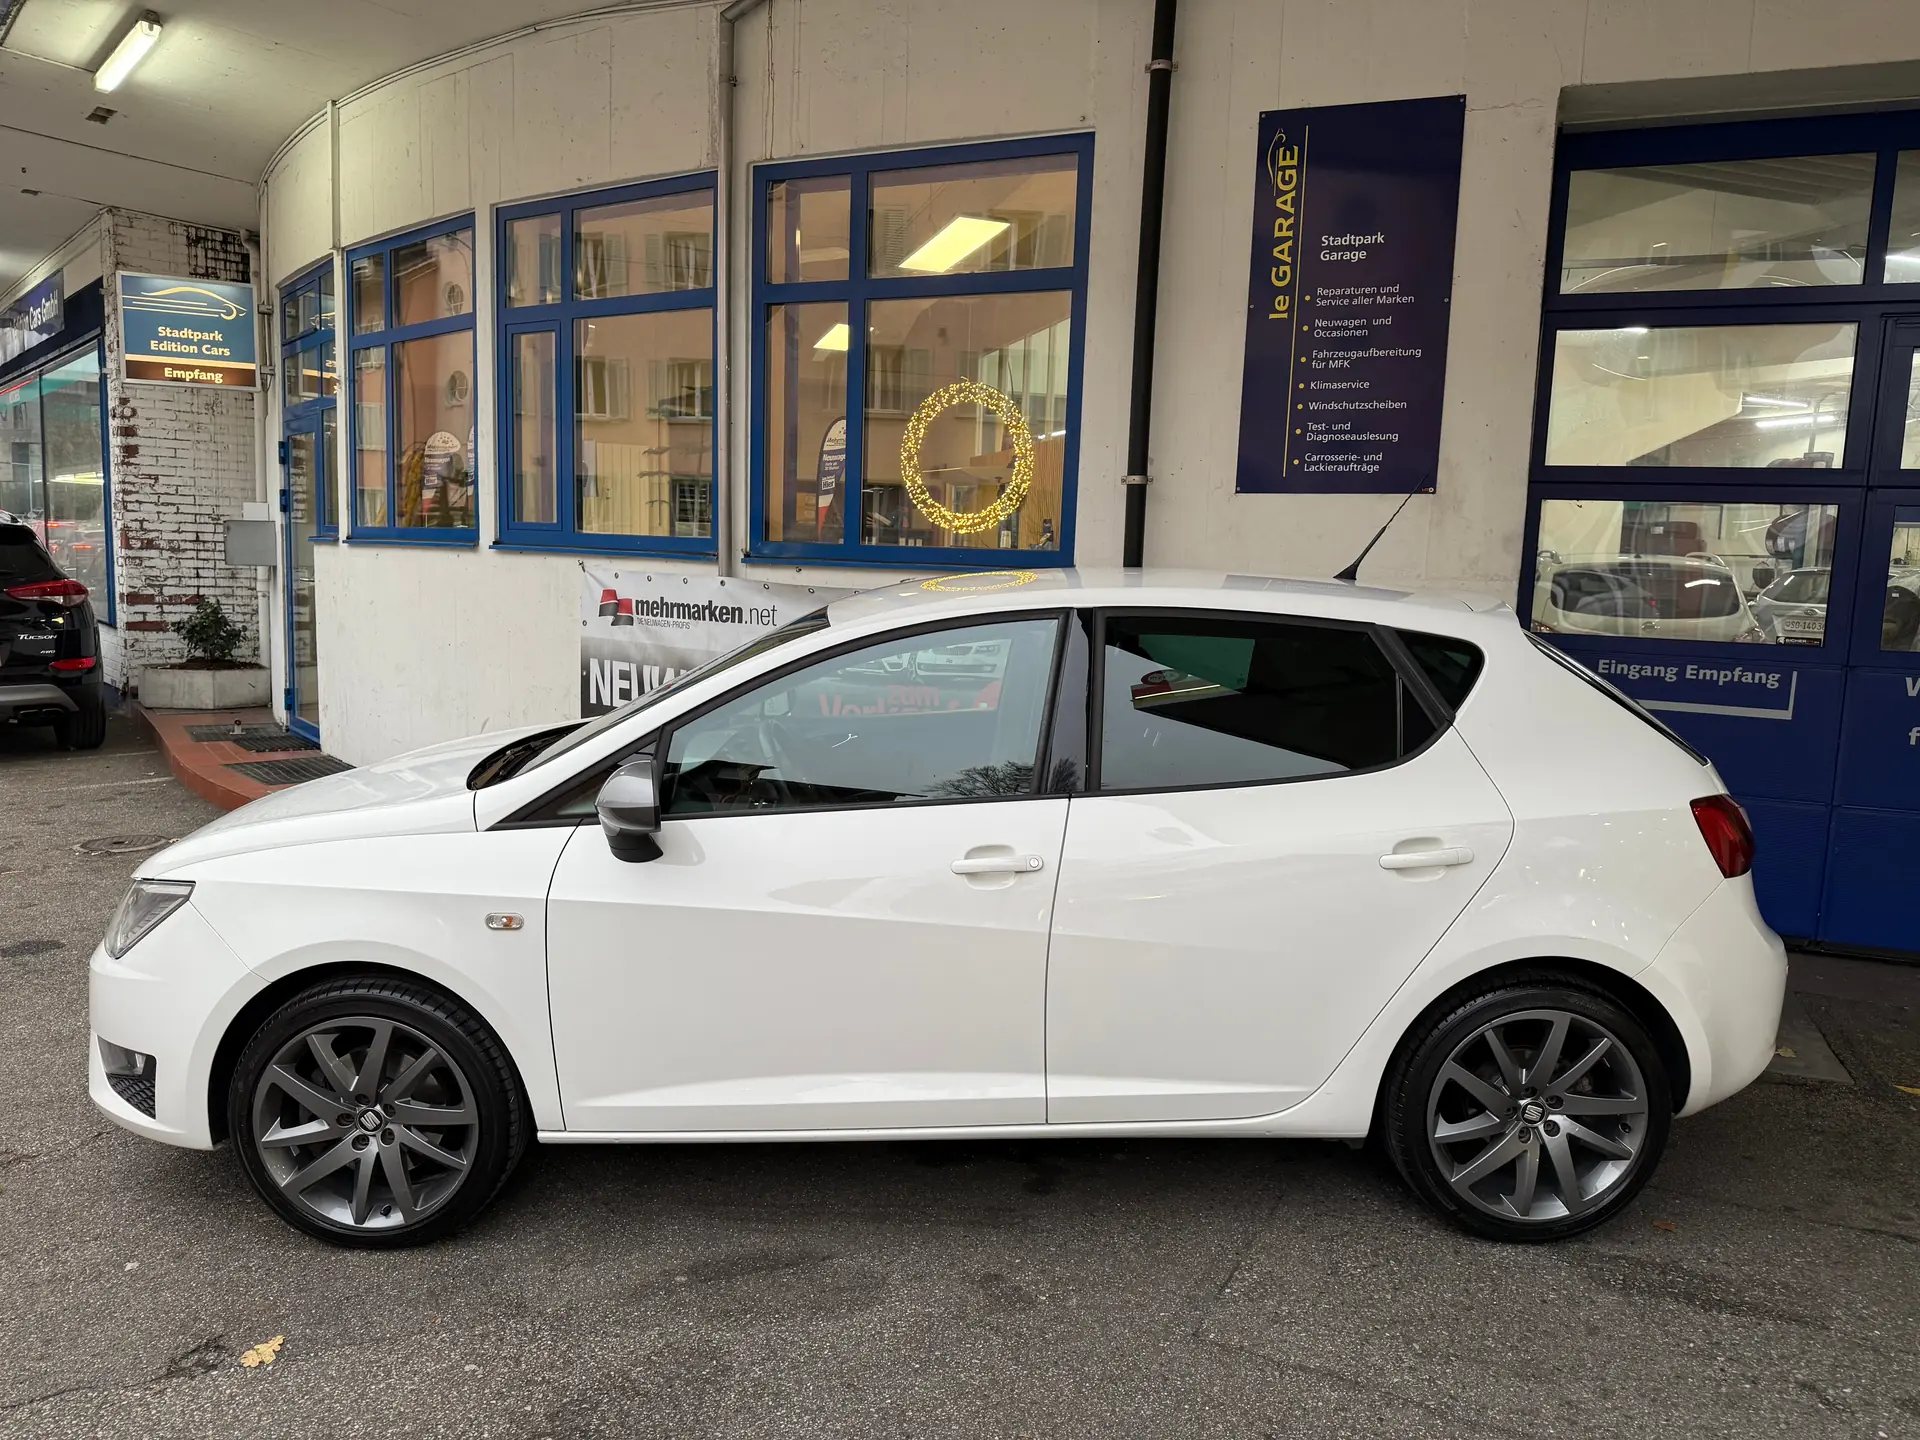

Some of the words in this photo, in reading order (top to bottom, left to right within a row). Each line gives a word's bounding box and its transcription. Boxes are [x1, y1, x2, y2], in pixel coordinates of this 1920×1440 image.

[1271, 145, 1298, 287] GARAGE
[1321, 232, 1385, 247] Stadtpark
[1320, 248, 1367, 262] Garage
[1316, 285, 1377, 298] Reparaturen
[1380, 284, 1400, 293] und
[1269, 295, 1289, 319] le
[1316, 298, 1350, 307] Service
[1351, 296, 1374, 305] aller
[1376, 295, 1415, 304] Marken
[29, 305, 42, 330] Cars
[41, 288, 59, 323] GmbH
[1314, 319, 1367, 328] Neuwagen
[1372, 315, 1392, 325] und
[158, 326, 223, 342] Stadtpark
[1313, 328, 1368, 338] Occasionen
[150, 340, 198, 354] Edition
[201, 344, 231, 356] Cars
[1312, 347, 1422, 359] Fahrzeugaufbereitung
[1312, 359, 1326, 369] für
[1328, 359, 1351, 368] MFK
[164, 367, 224, 384] Empfang
[1310, 380, 1370, 390] Klimaservice
[1308, 400, 1407, 411] Windschutzscheiben
[1307, 422, 1329, 431] Test-
[1331, 422, 1351, 431] und
[1306, 431, 1399, 442] Diagnoseauslesung
[1304, 453, 1360, 462] Carrosserie-
[1363, 452, 1383, 461] und
[1304, 463, 1380, 473] Lackieraufträge
[635, 596, 777, 626] mehrmarken.net
[1598, 659, 1679, 682] Eingang
[1685, 665, 1781, 689] Empfang
